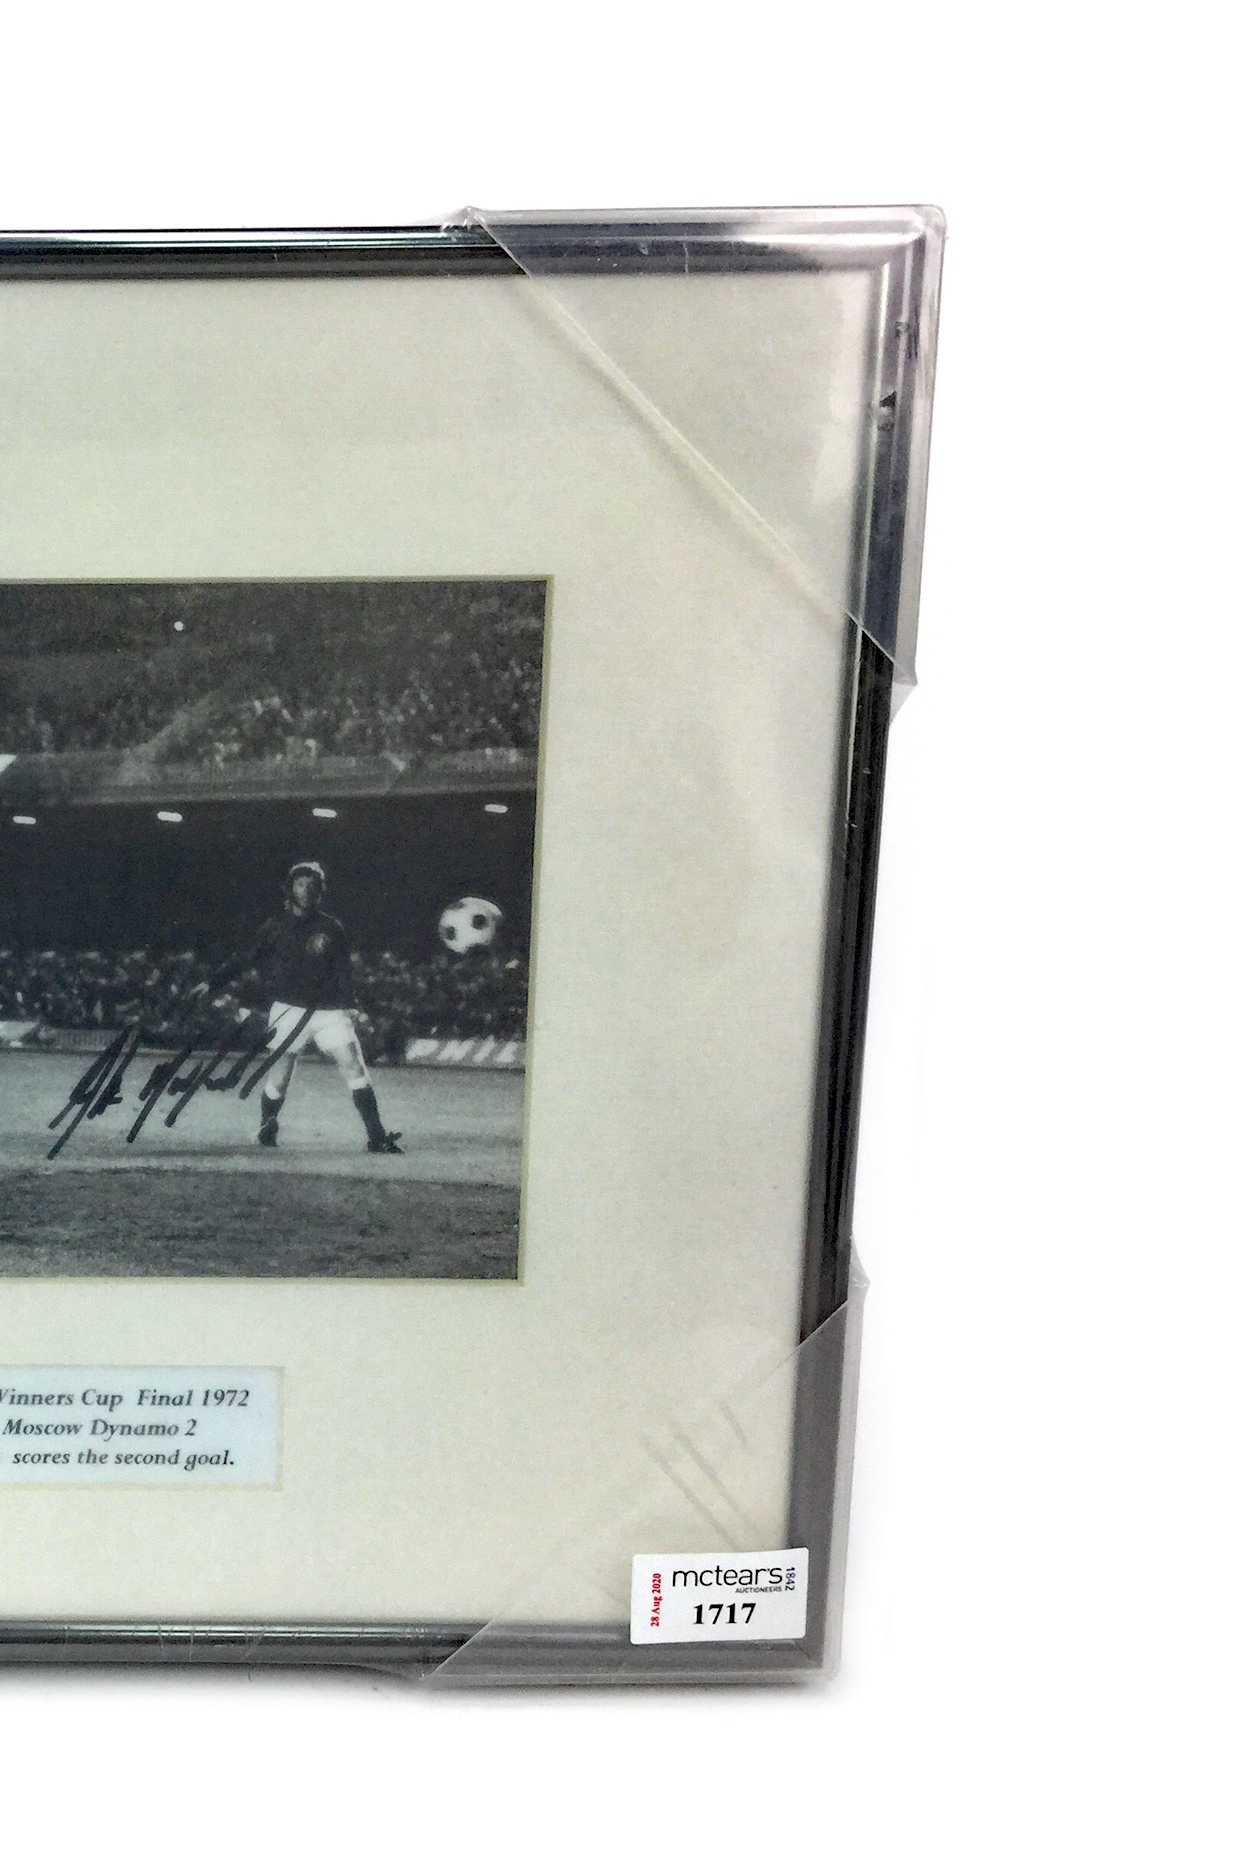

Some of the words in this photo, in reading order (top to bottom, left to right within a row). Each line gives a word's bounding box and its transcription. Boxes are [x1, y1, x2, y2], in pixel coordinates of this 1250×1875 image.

[81, 1388, 123, 1412] Cup
[137, 1388, 194, 1407] Final
[202, 1389, 250, 1407] 1972
[2, 1418, 83, 1436] Moscow
[90, 1419, 180, 1442] Dynamo
[184, 1418, 198, 1437] 2
[12, 1453, 71, 1465] scores
[77, 1448, 109, 1465] the
[114, 1448, 181, 1465] second
[183, 1449, 235, 1472] goal.
[652, 1573, 662, 1594] 2020
[785, 1566, 796, 1591] 1842
[735, 1586, 783, 1594] AUCTIONEERS
[652, 1596, 663, 1615] Aug
[693, 1603, 757, 1625] 1717
[650, 1616, 661, 1627] 28
